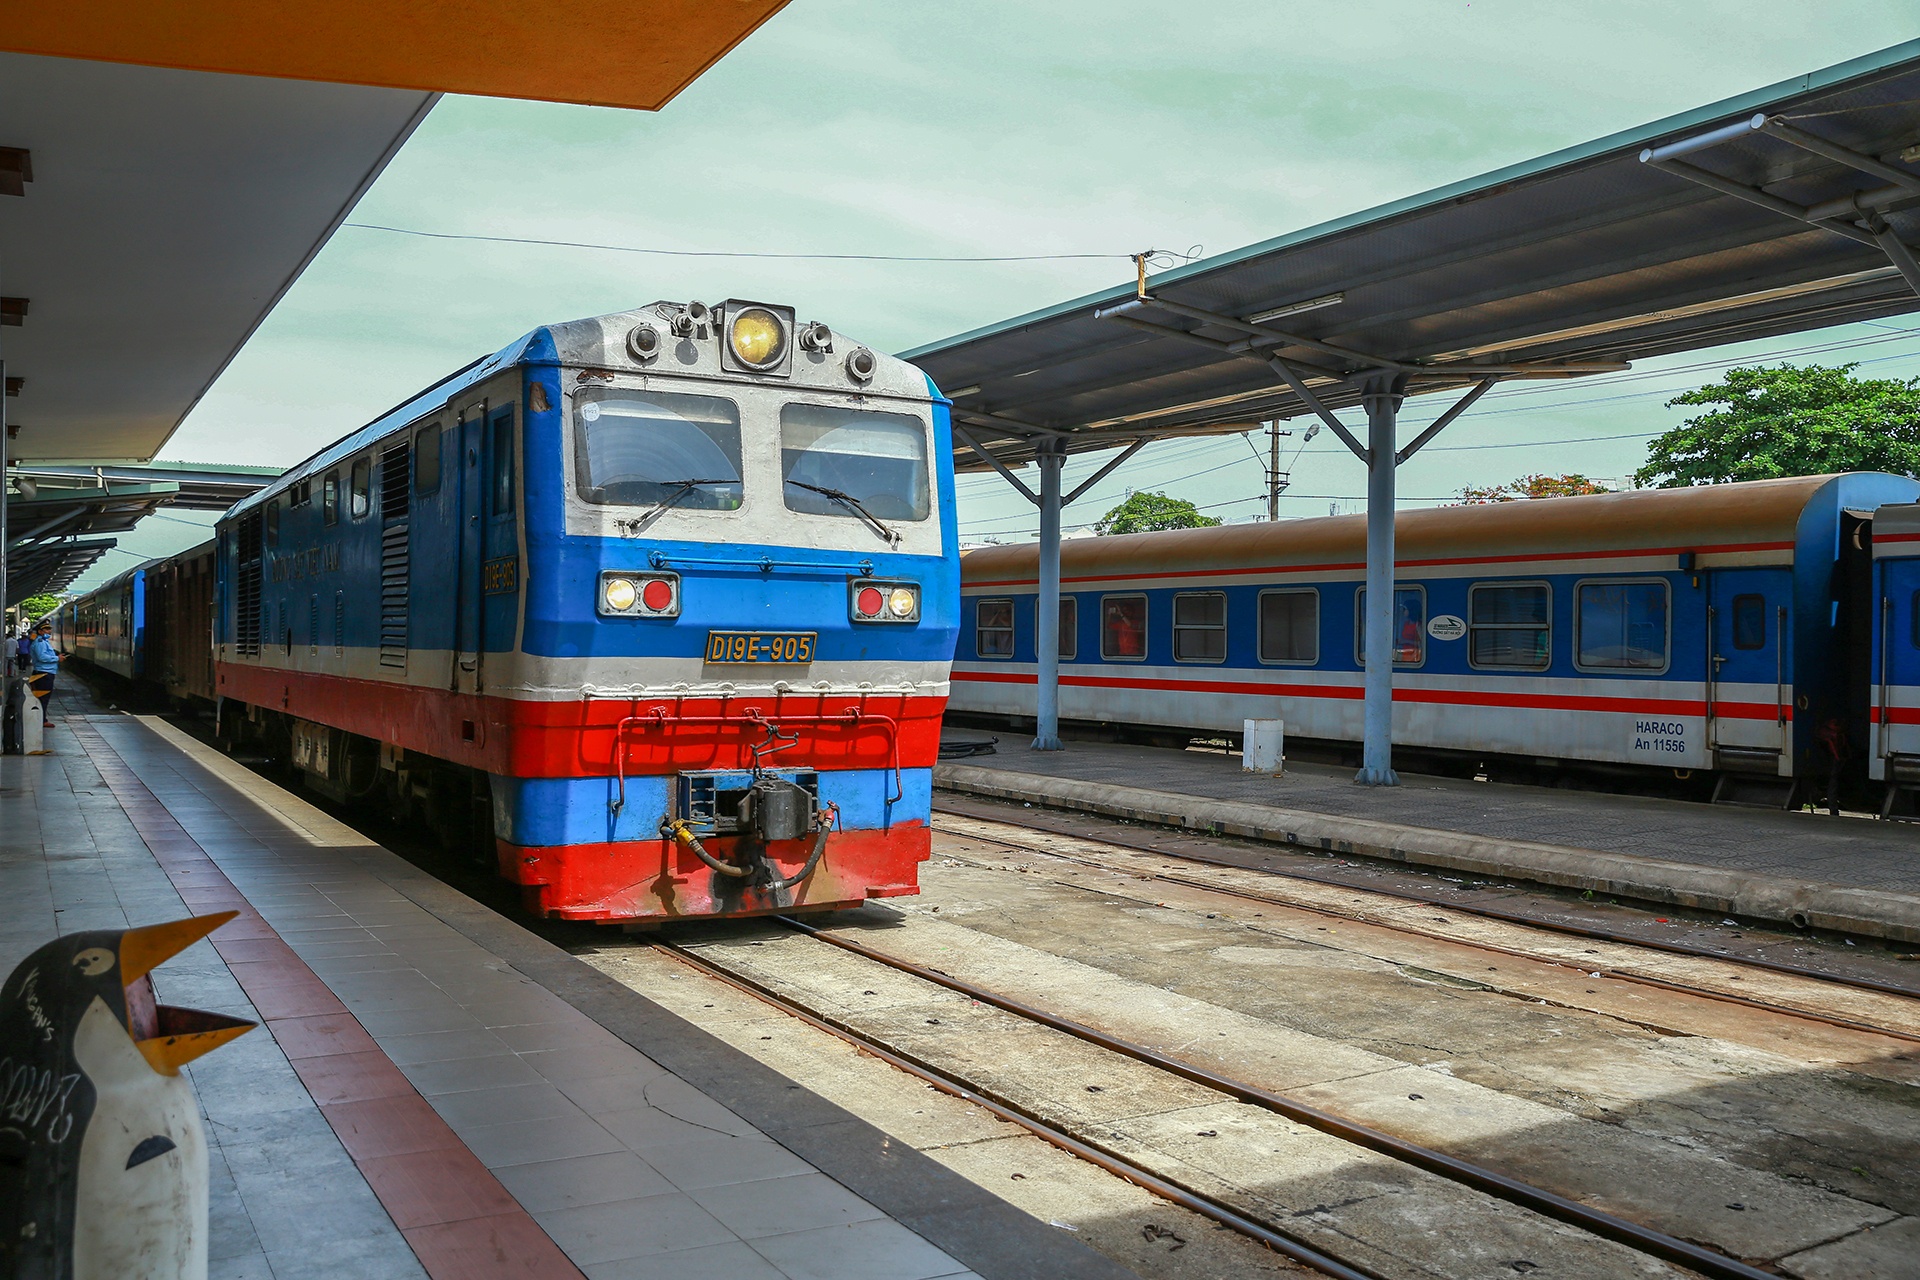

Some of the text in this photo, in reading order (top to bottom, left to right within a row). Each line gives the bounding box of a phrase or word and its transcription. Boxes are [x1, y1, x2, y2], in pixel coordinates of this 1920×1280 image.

[485, 560, 515, 590] D19E-905
[711, 636, 811, 660] D19E-905
[1636, 721, 1684, 736] HARACO
[1635, 738, 1685, 753] An 11556
